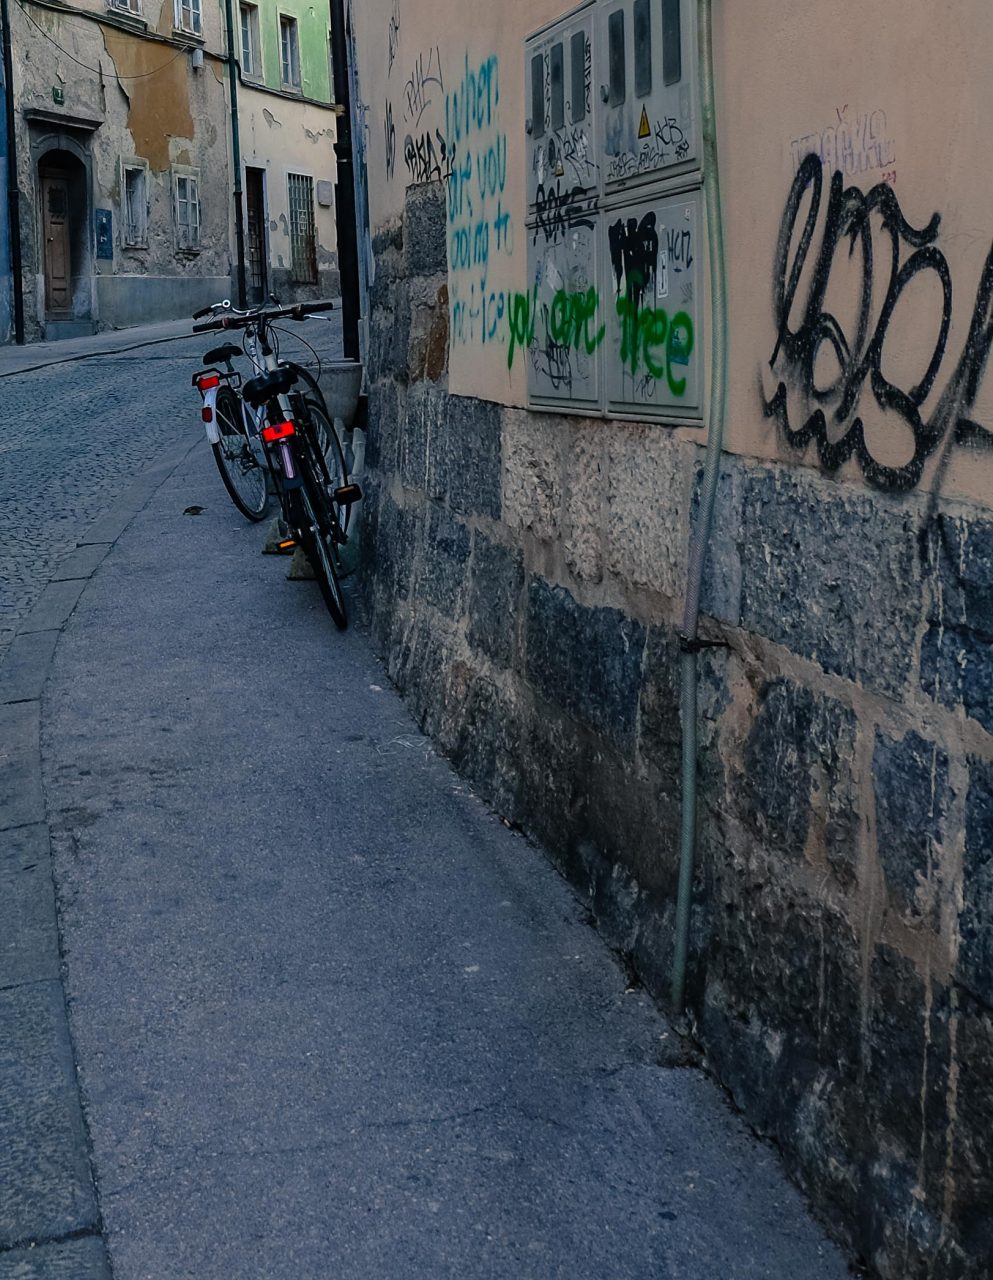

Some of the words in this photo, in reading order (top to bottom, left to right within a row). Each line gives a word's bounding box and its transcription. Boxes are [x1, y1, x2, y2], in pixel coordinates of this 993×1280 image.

[445, 49, 499, 146] when
[448, 148, 473, 222] are
[477, 134, 507, 200] you
[494, 201, 514, 255] to
[507, 287, 538, 369] you
[551, 285, 605, 354] are
